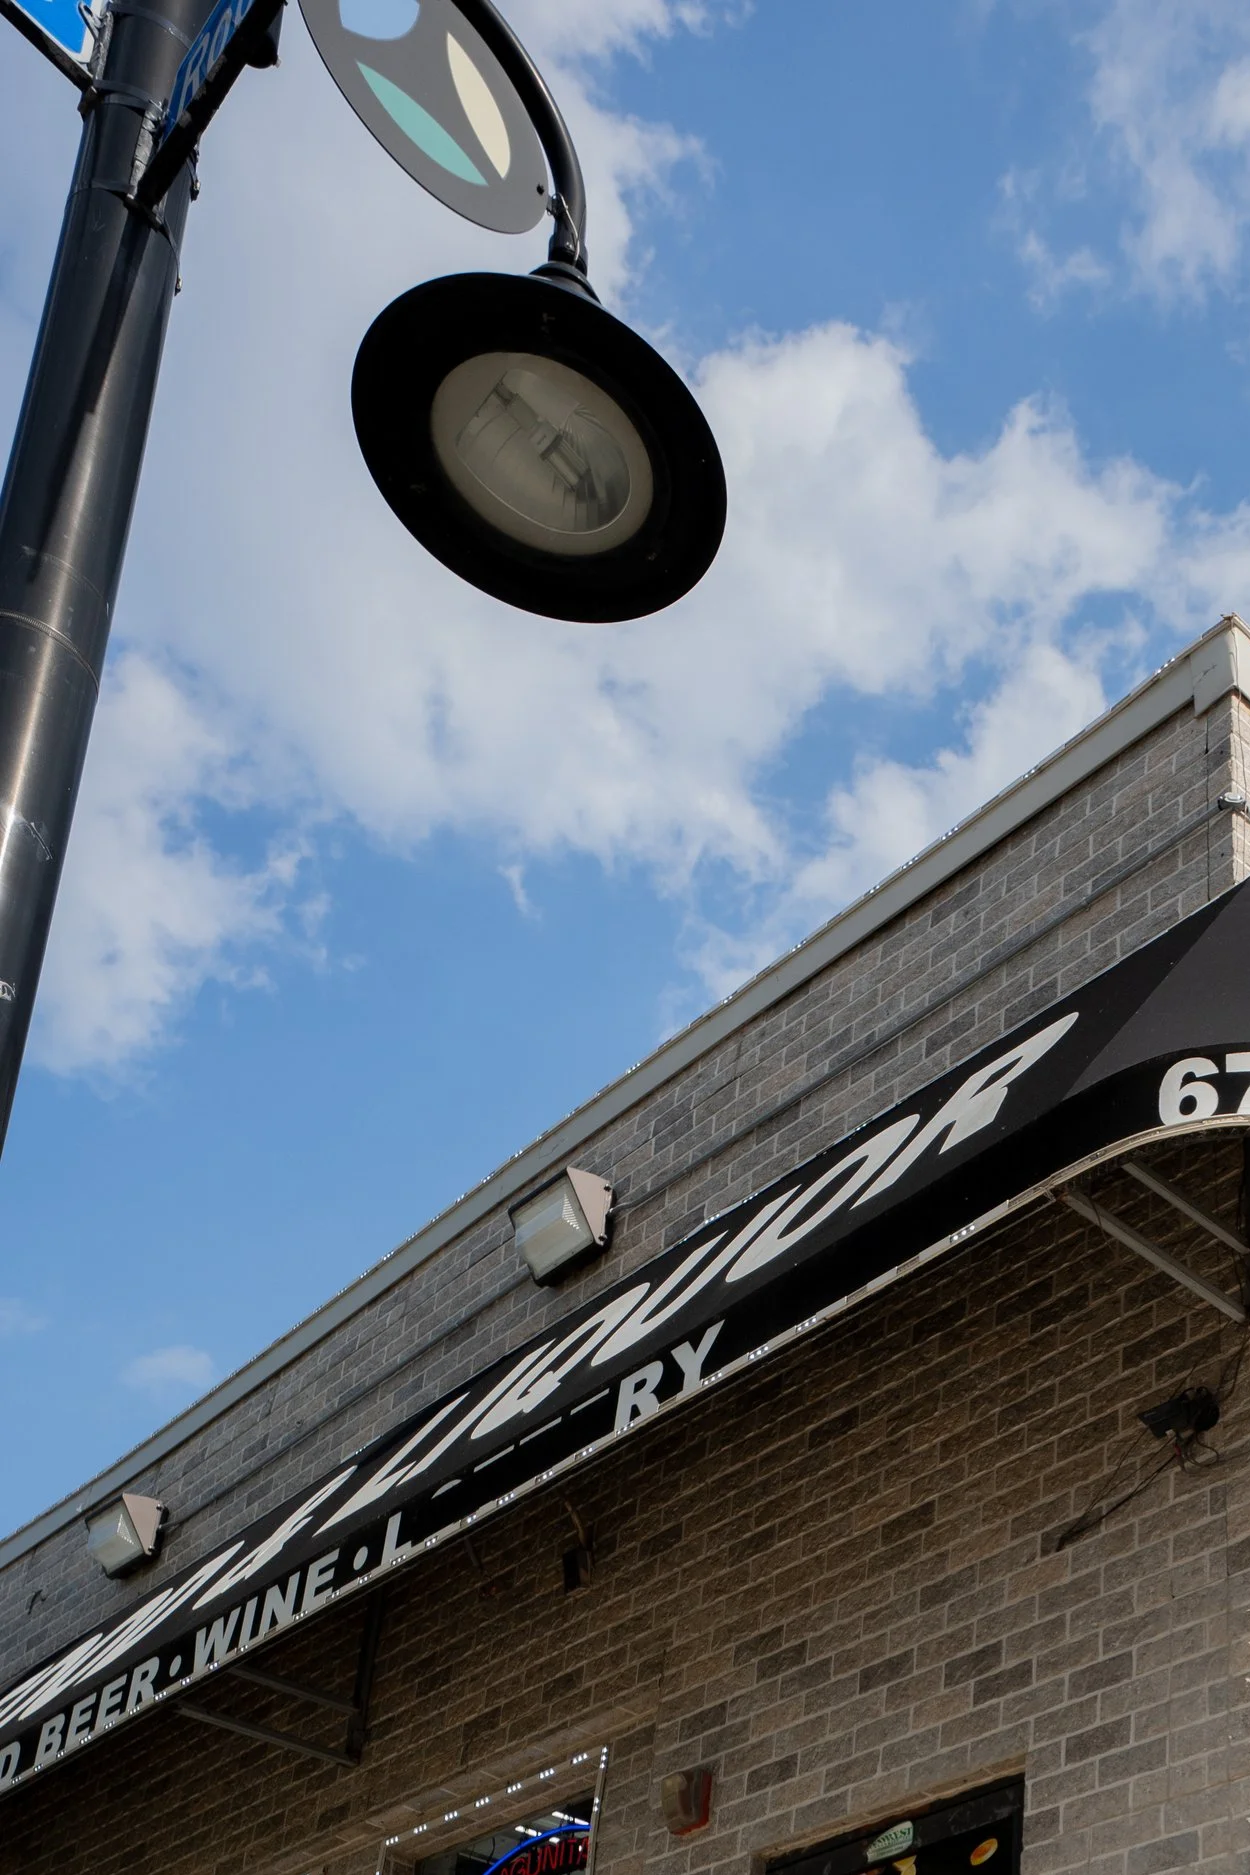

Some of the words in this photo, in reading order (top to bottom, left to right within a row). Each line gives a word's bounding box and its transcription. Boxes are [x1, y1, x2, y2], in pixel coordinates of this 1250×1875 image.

[193, 1466, 357, 1610] &
[313, 1011, 1079, 1537] LIQUOR
[34, 1656, 160, 1768] BEER
[193, 1548, 340, 1675] WINE
